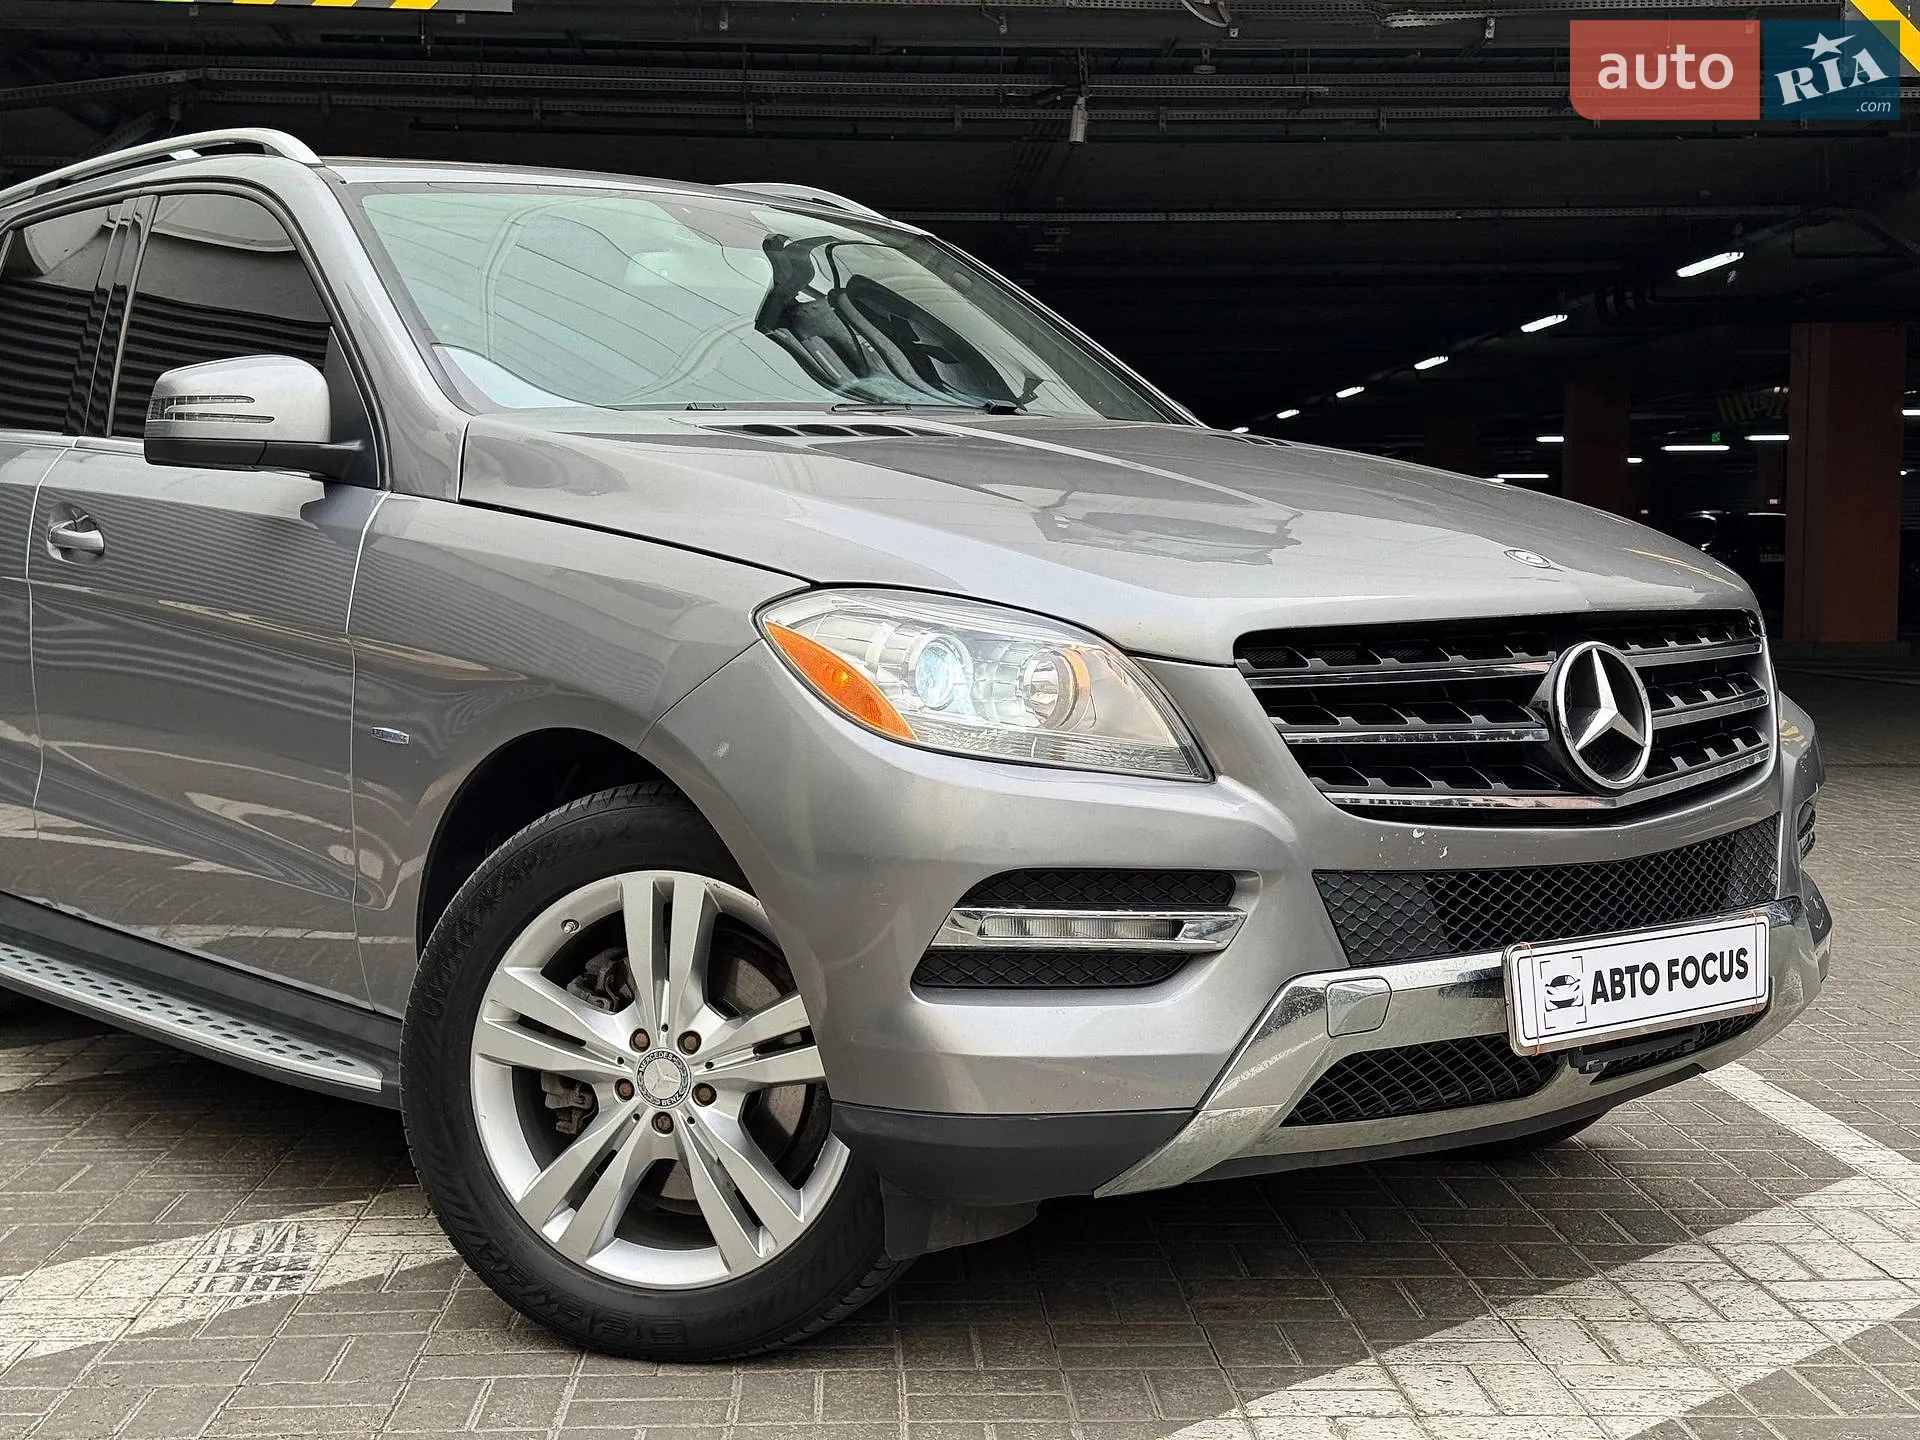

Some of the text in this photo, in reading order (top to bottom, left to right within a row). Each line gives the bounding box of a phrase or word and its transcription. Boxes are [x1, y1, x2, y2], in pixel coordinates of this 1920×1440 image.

[1667, 947, 1749, 992] FOCUS
[638, 1050, 674, 1072] MERCEDES
[661, 1092, 681, 1106] BENZ
